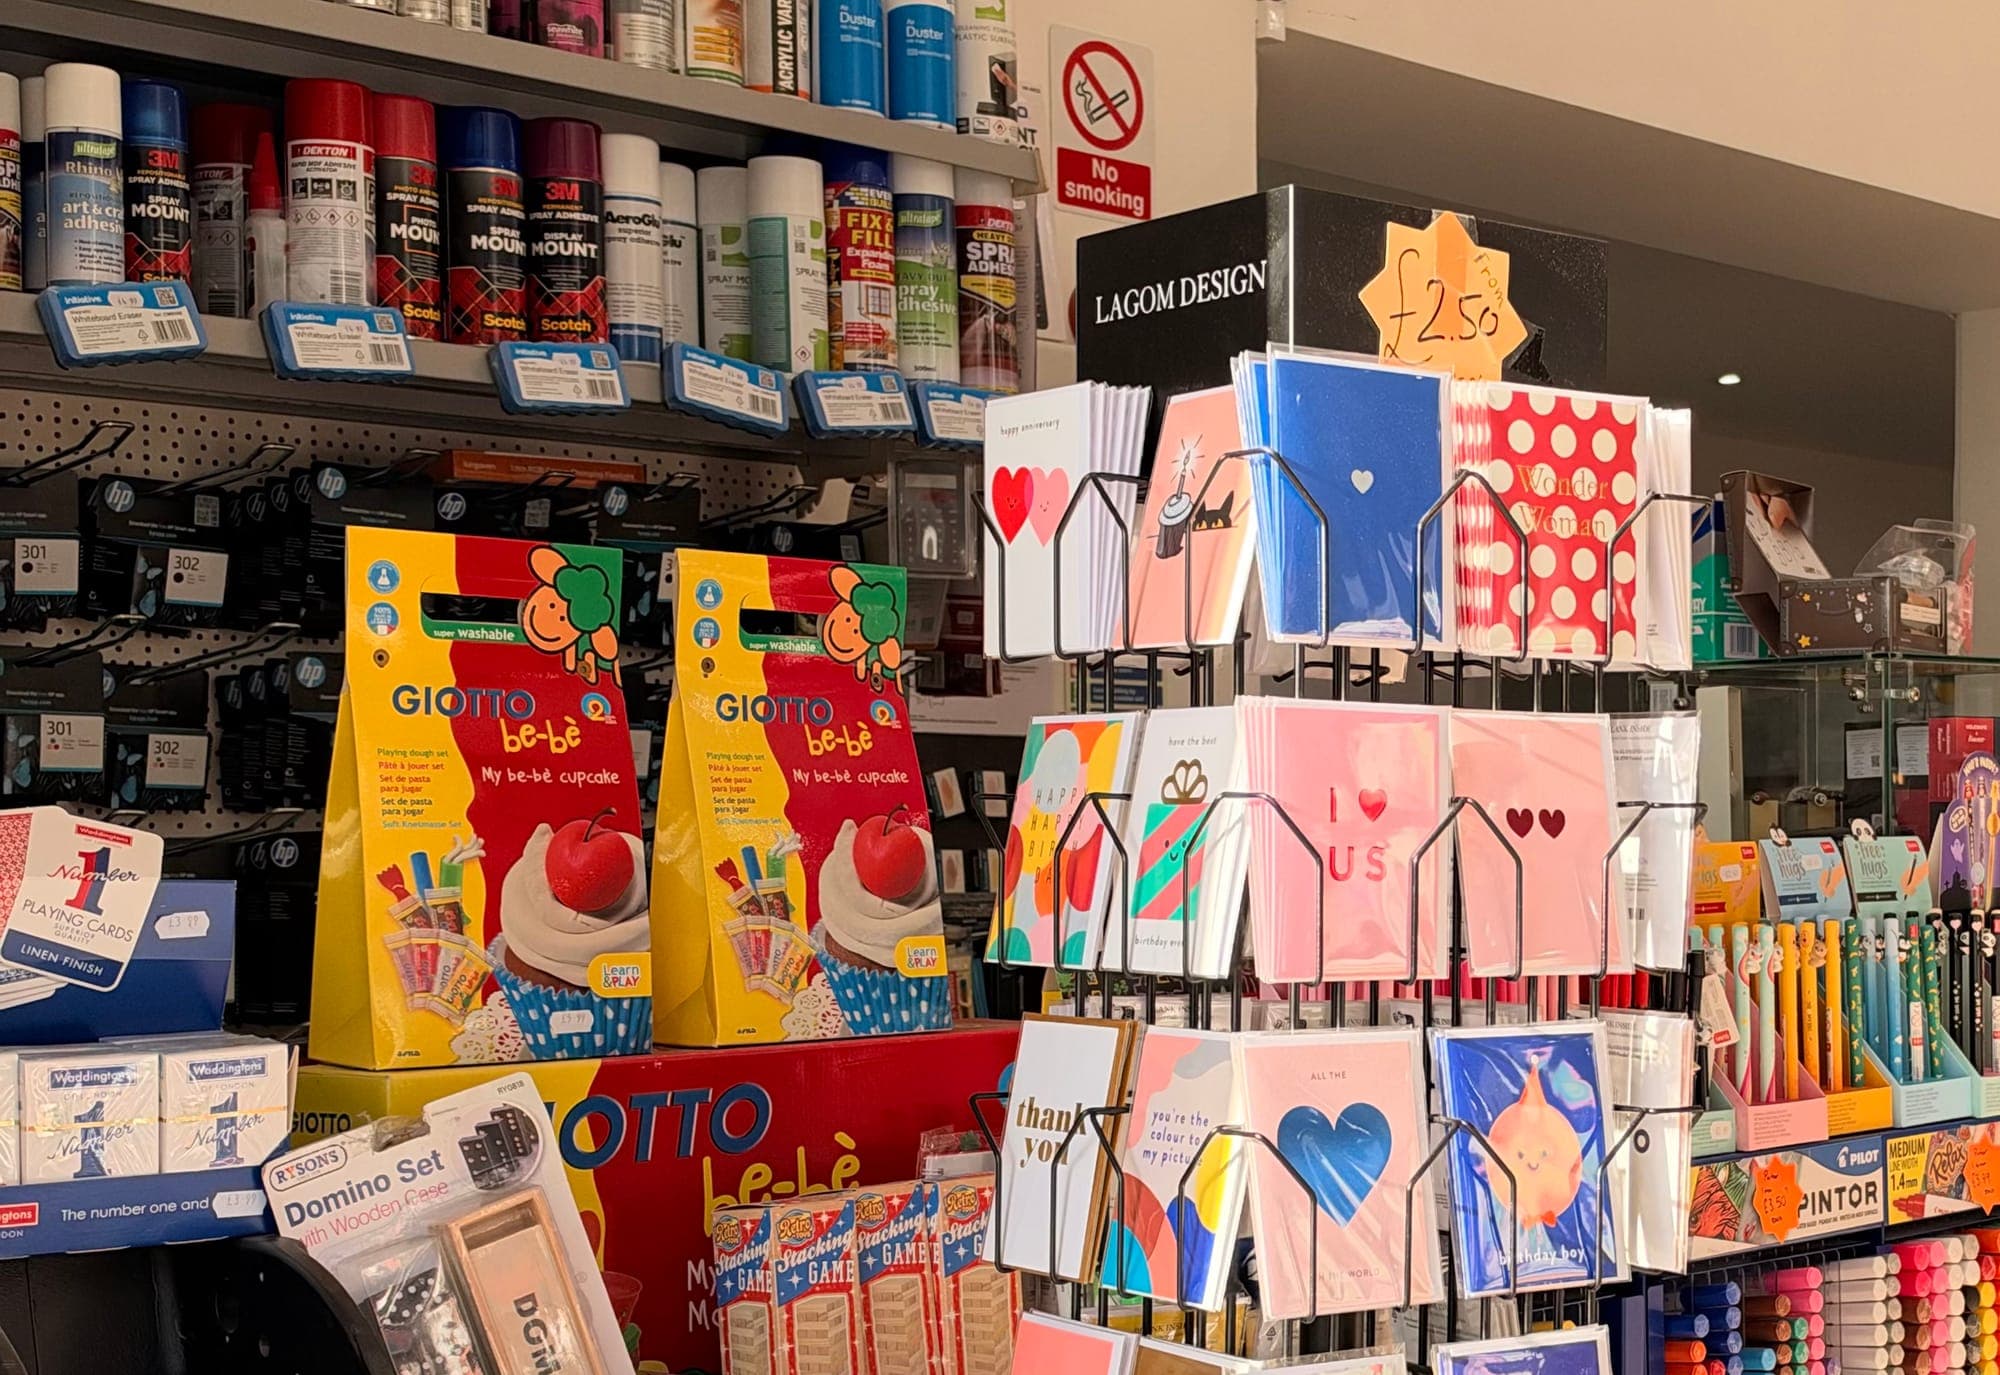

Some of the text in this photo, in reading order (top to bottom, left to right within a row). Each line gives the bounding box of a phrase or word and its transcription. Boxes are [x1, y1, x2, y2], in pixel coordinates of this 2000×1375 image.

[839, 12, 876, 28] Duster
[906, 26, 943, 41] Duster
[777, 28, 794, 91] ACRYLIC
[148, 150, 179, 170] 3M
[302, 146, 350, 157] DEKTON
[65, 161, 113, 178] Rhino
[1092, 157, 1119, 184] No
[148, 195, 180, 207] SPRAY
[546, 182, 580, 201] 3M
[1065, 181, 1145, 217] smoking
[62, 202, 103, 215] art &
[132, 203, 190, 224] MOUNT
[467, 204, 499, 215] SPRAY
[554, 212, 599, 224] ADHESIVE
[847, 212, 882, 230] FIX
[489, 226, 521, 239] SPRAY
[544, 232, 584, 242] DISPLAY
[851, 229, 893, 250] FILL
[976, 231, 1006, 242] HEAVY
[531, 242, 599, 259] MOUNT
[861, 258, 890, 272] Foam
[1095, 260, 1267, 325] LAGOM DESIGN
[1384, 248, 1499, 366] £2.50
[72, 312, 143, 325] Whiteboard Eraser
[541, 314, 592, 333] Scotch
[295, 330, 337, 341] Whiteboard
[1000, 418, 1061, 437] happy anniversary
[317, 467, 346, 499] hp
[1516, 464, 1609, 500] Wonder
[105, 480, 135, 512] hp
[438, 492, 466, 520] hp
[1519, 504, 1608, 538] Woman
[21, 545, 47, 559] 301
[174, 556, 200, 571] 302
[433, 626, 516, 641] super washable
[769, 639, 817, 653] washable
[296, 656, 326, 688] hp
[391, 683, 536, 720] GIOTTO
[715, 692, 834, 727] GIOTTO
[46, 721, 72, 736] 301
[500, 716, 582, 754] be-bè
[154, 741, 180, 755] 302
[804, 721, 874, 756] be-bè
[1168, 736, 1217, 747] have the best
[377, 748, 449, 759] Playing dough set
[706, 751, 765, 762] Playing dough set
[407, 762, 445, 772] jouer set
[481, 766, 620, 787] My be-bè cupcake
[751, 765, 763, 773] set
[379, 774, 431, 785] Set de pasta
[792, 768, 910, 787] My be-bè cupcake
[380, 785, 423, 796] para jugar
[381, 796, 433, 807] Set de pasta
[714, 805, 731, 814] para
[1330, 787, 1337, 823] I
[381, 807, 424, 818] para jogar
[271, 838, 299, 868] hp
[47, 863, 140, 883] Number
[1779, 858, 1806, 880] hugs
[1860, 858, 1889, 880] hugs
[22, 898, 134, 943] PLAYING CARDS
[54, 922, 96, 940] SUPERIOR
[54, 930, 90, 945] QUALITY
[1135, 935, 1168, 948] birthday
[20, 943, 104, 977] LINEN FINISH
[906, 946, 937, 958] Learn
[603, 963, 640, 977] Learn
[907, 957, 937, 969] &PLAY
[603, 976, 640, 989] &PLAY
[192, 1060, 264, 1078] Waddingtons
[1310, 1071, 1347, 1081] ALL THE
[1015, 1096, 1089, 1136] thank
[1152, 1107, 1209, 1127] you're the
[185, 1112, 265, 1151] Number
[1150, 1128, 1201, 1147] colour to
[47, 1123, 135, 1160] Number
[1889, 1138, 1926, 1159] MEDIUM
[1019, 1136, 1071, 1169] you
[1142, 1148, 1160, 1163] my
[1850, 1149, 1880, 1166] PILOT
[275, 1148, 340, 1184] RYSONS
[1929, 1141, 1966, 1185] Relax
[284, 1148, 446, 1228] Domino Set
[62, 1196, 209, 1222] The number one and
[328, 1197, 402, 1237] Wooden
[403, 1179, 450, 1207] Case
[855, 1199, 884, 1220] Retro
[945, 1193, 978, 1214] Retro
[1798, 1181, 1878, 1219] PINTOR
[715, 1221, 740, 1242] Retro
[779, 1217, 811, 1238] Retro
[856, 1212, 924, 1253] Stacking
[715, 1239, 770, 1276] Stacking
[777, 1229, 852, 1273] Stacking
[882, 1241, 927, 1265] GAME
[1562, 1246, 1586, 1262] boy
[737, 1268, 772, 1293] GAME
[808, 1259, 855, 1284] GAME
